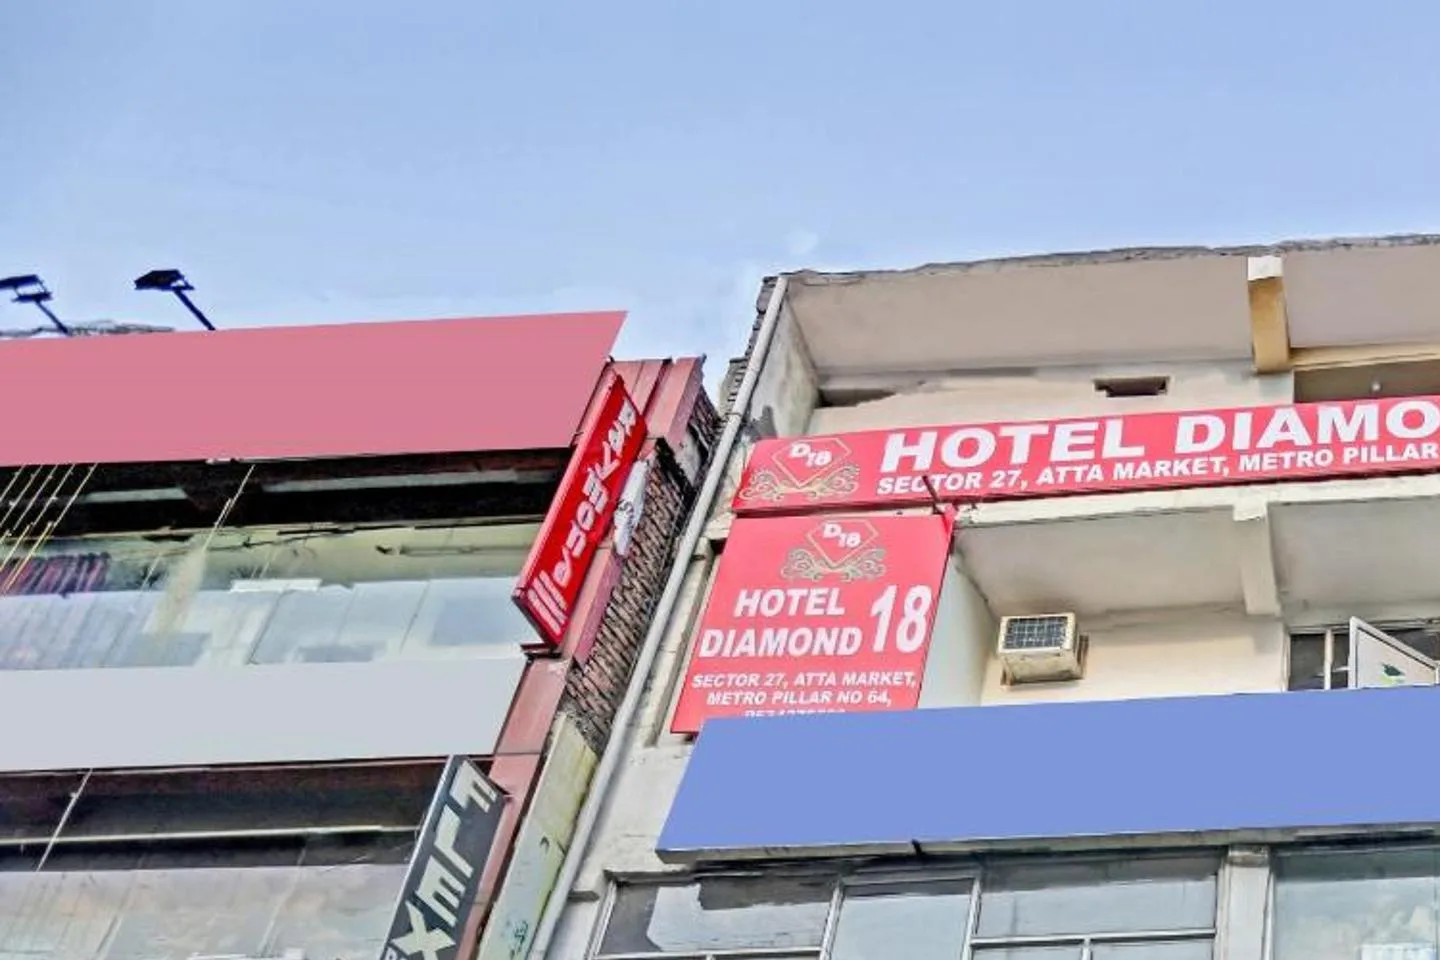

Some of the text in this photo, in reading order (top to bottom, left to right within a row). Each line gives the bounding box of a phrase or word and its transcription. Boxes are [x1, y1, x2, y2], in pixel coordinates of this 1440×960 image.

[880, 418, 1145, 473] HOTEL
[876, 471, 983, 496] SECTOR
[991, 468, 1028, 491] 27,
[1036, 464, 1103, 486] ATTA
[1112, 454, 1229, 481] MARKET,
[1239, 449, 1334, 472] METRO
[1343, 442, 1438, 464] PILLAR
[698, 583, 932, 658] DIAMOND 18
[733, 587, 846, 618] HOTEL
[691, 670, 917, 689] SECTOR 27, ATTA MARKET,
[706, 689, 893, 706] METRO PILLAR NO 64,
